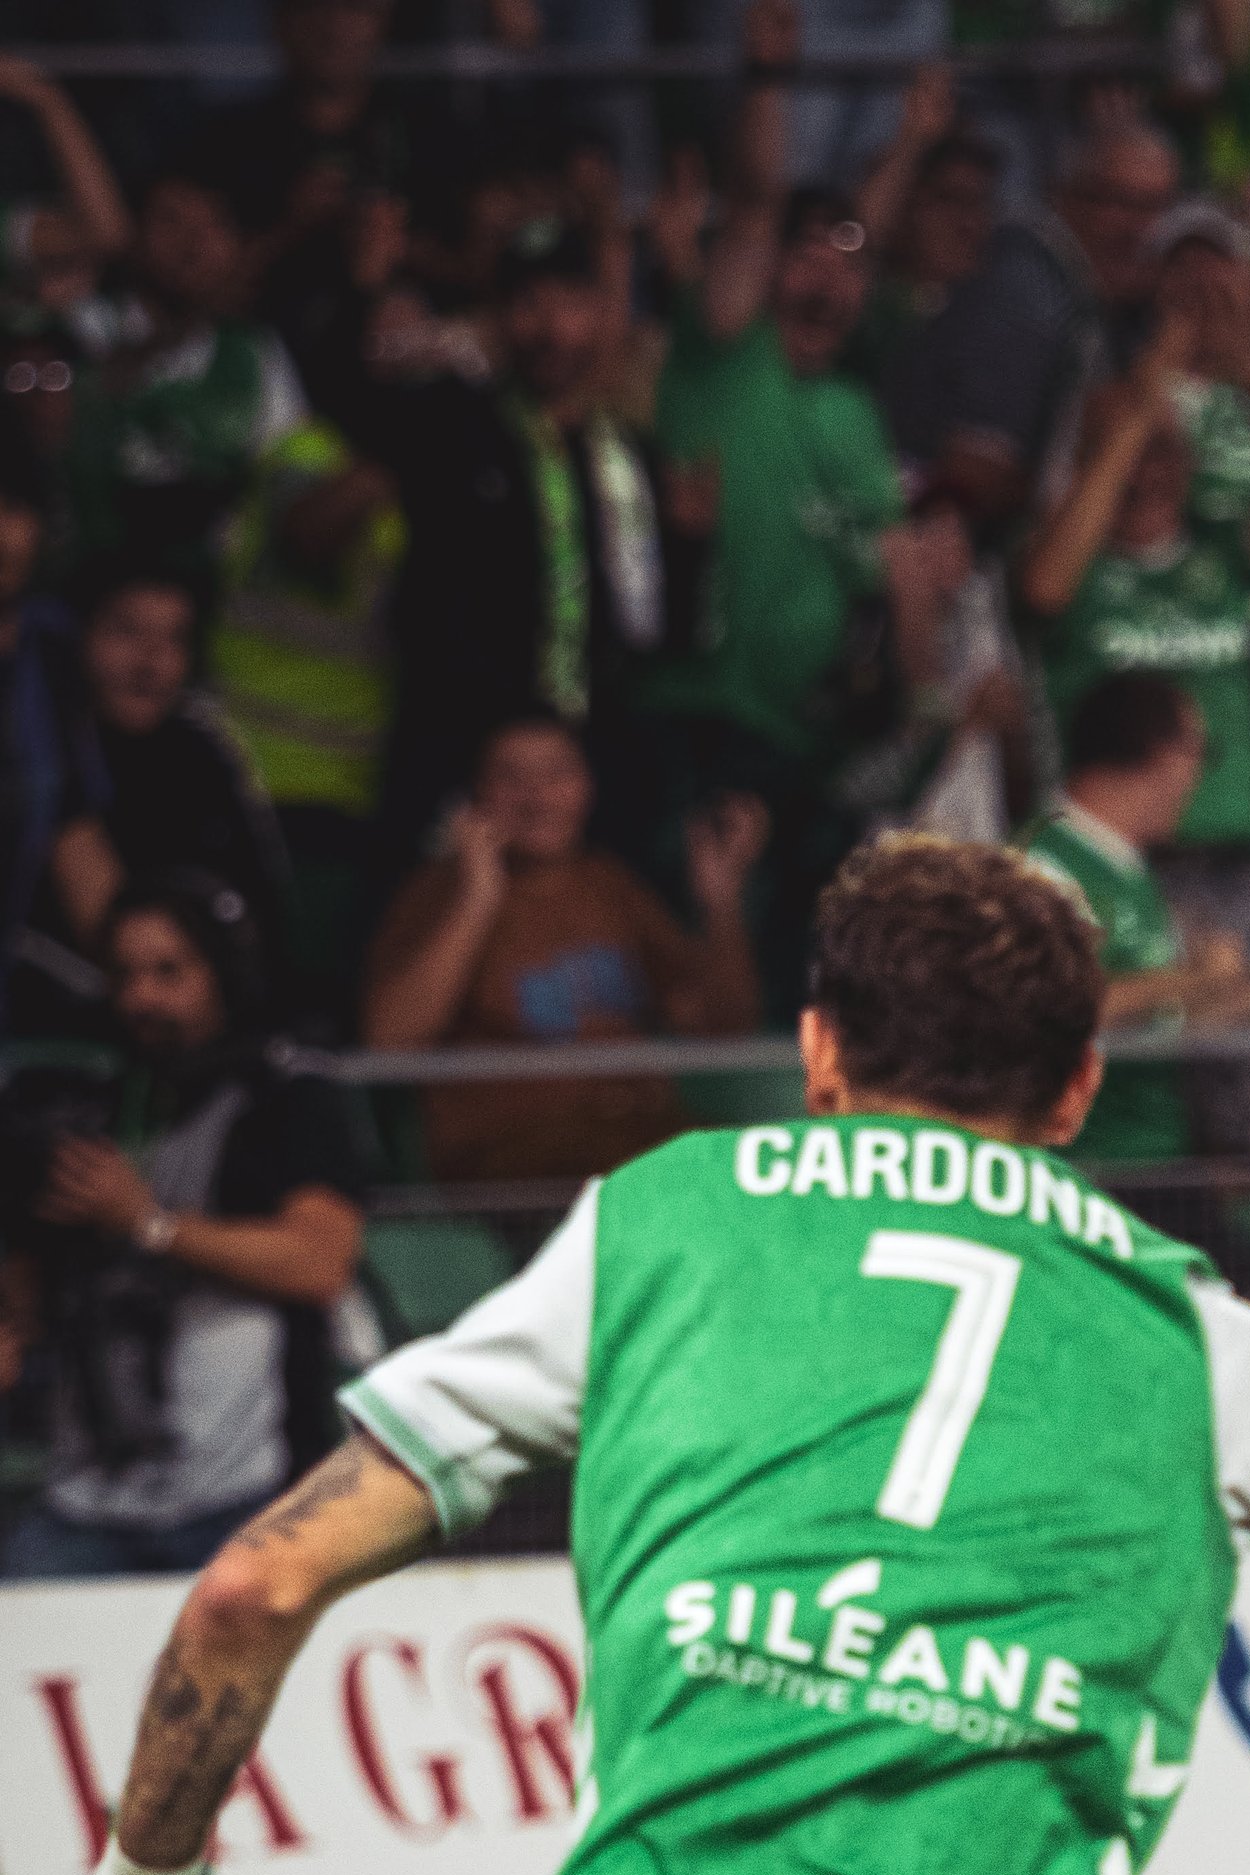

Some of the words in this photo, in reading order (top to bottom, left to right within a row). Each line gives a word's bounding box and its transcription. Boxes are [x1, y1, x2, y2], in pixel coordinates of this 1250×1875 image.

[736, 1126, 1133, 1259] CARDONA
[861, 1230, 1021, 1530] 7
[664, 1559, 1083, 1732] SILÉANE
